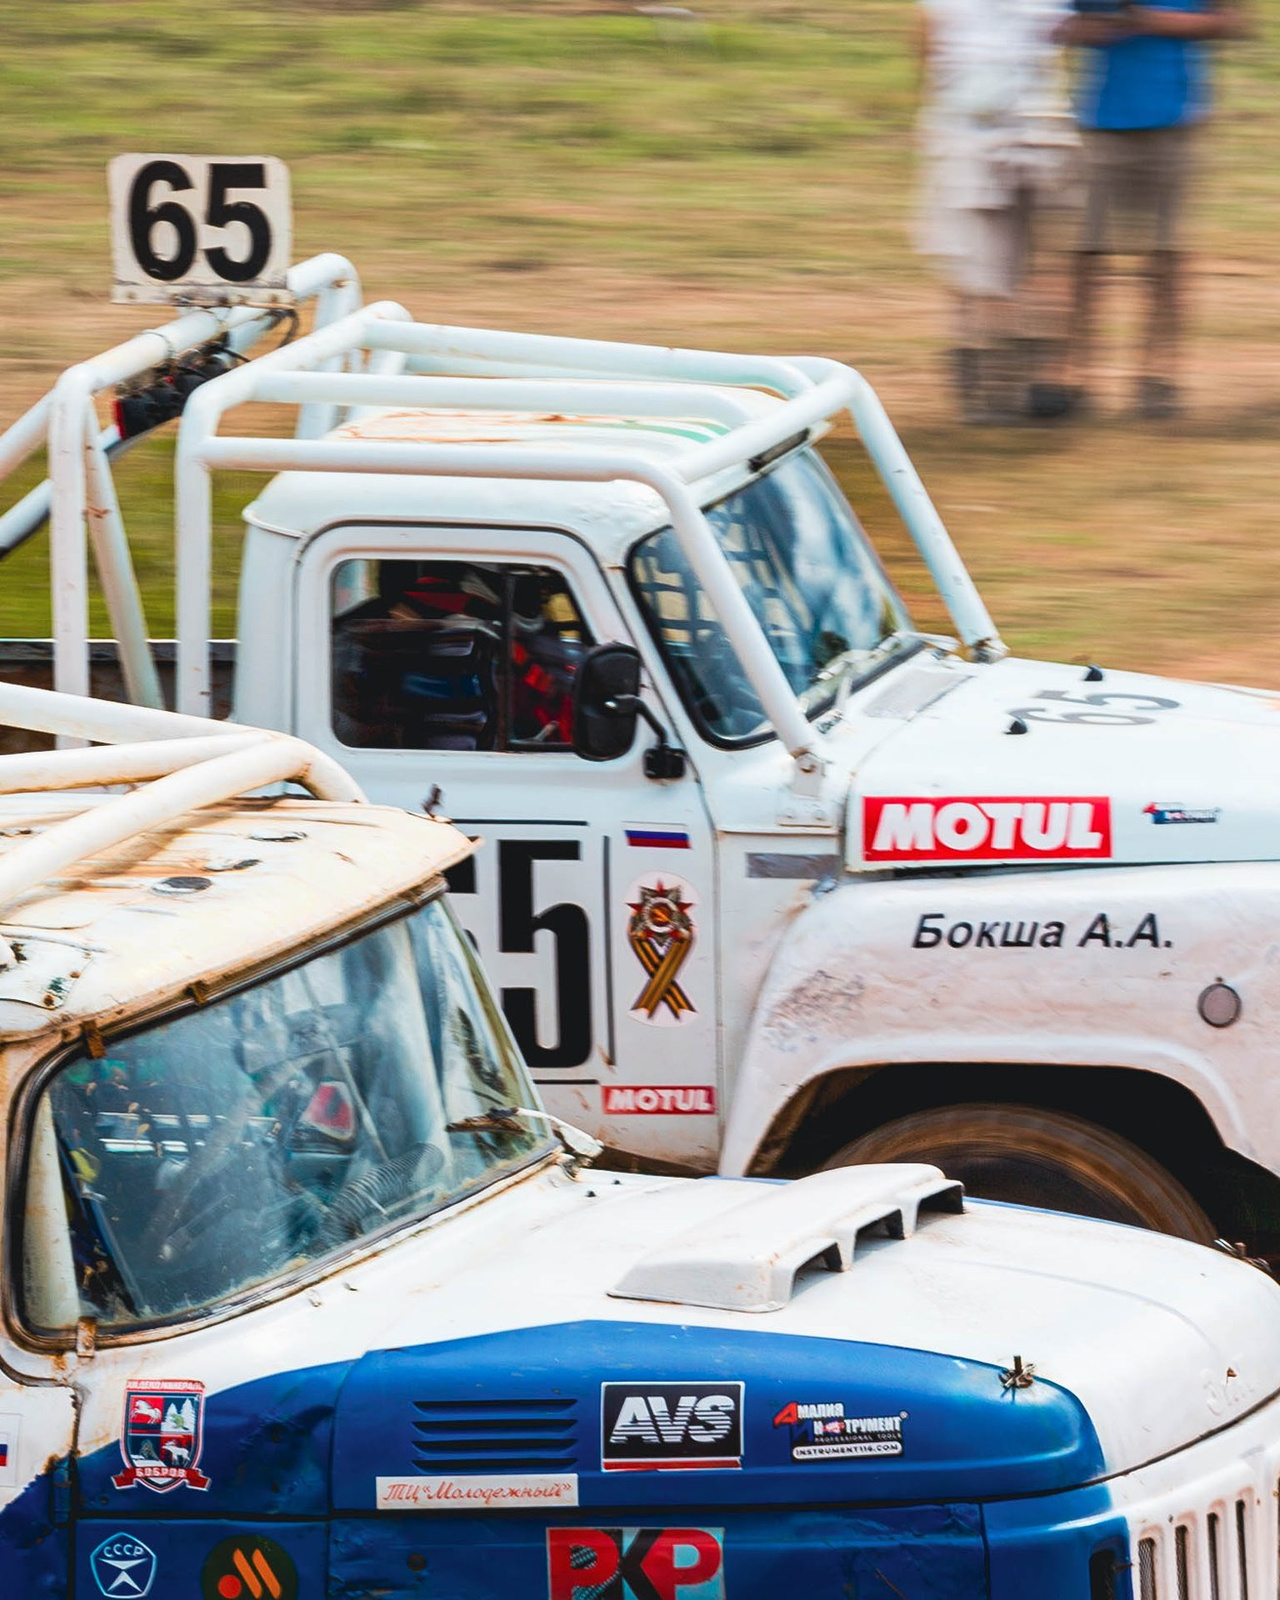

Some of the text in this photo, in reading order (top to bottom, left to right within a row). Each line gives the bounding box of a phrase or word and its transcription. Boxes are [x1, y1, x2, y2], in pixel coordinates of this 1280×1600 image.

[128, 159, 272, 282] 65
[871, 802, 1104, 851] MOTUL
[912, 912, 1174, 950] Бокша А.А.
[607, 1089, 712, 1112] MOTUL
[609, 1394, 737, 1445] AVS
[135, 1467, 187, 1478] БОБРОВ
[103, 1543, 145, 1558] СССР
